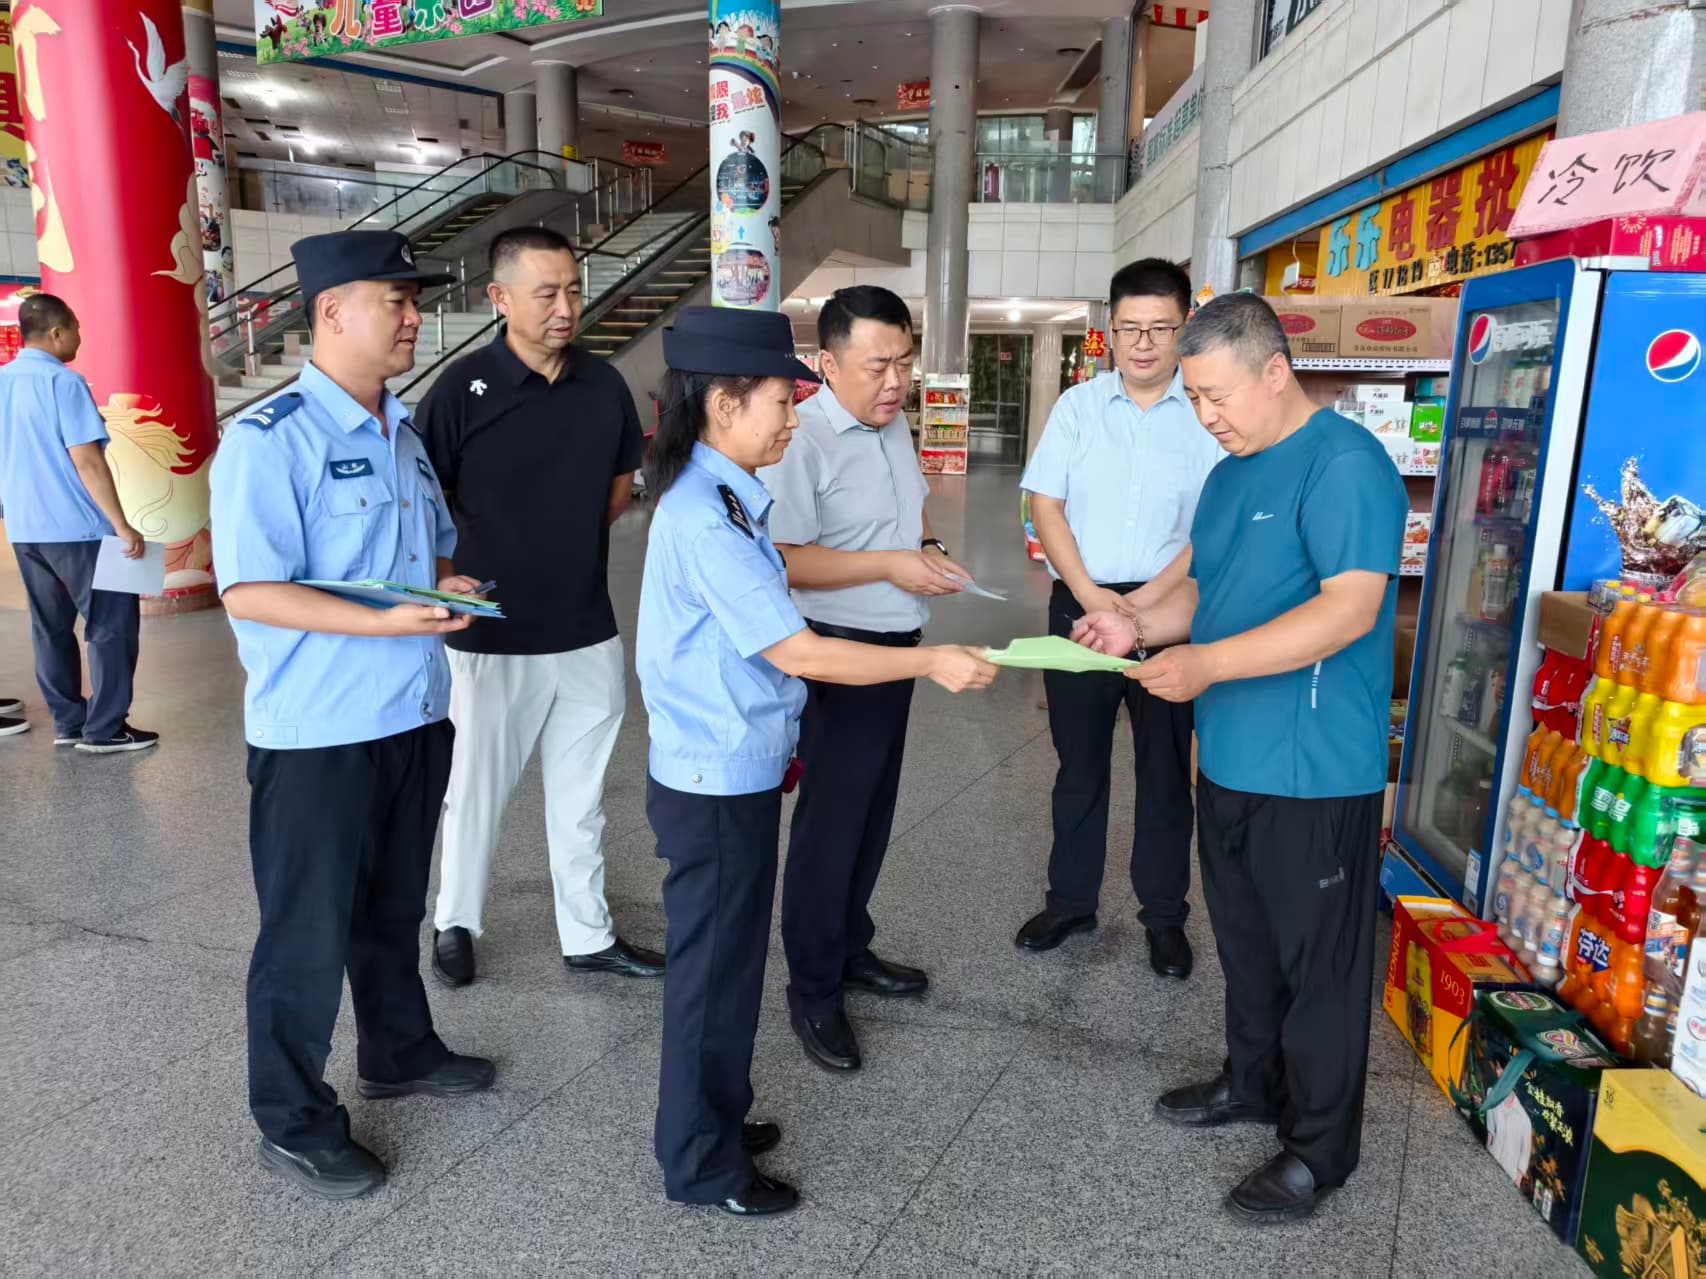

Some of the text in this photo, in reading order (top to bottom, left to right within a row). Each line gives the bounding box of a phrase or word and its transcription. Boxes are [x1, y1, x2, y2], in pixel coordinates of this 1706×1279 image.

[1537, 149, 1676, 205] 冷饮
[1577, 928, 1611, 967] 芬达
[1440, 970, 1465, 1005] 1903
